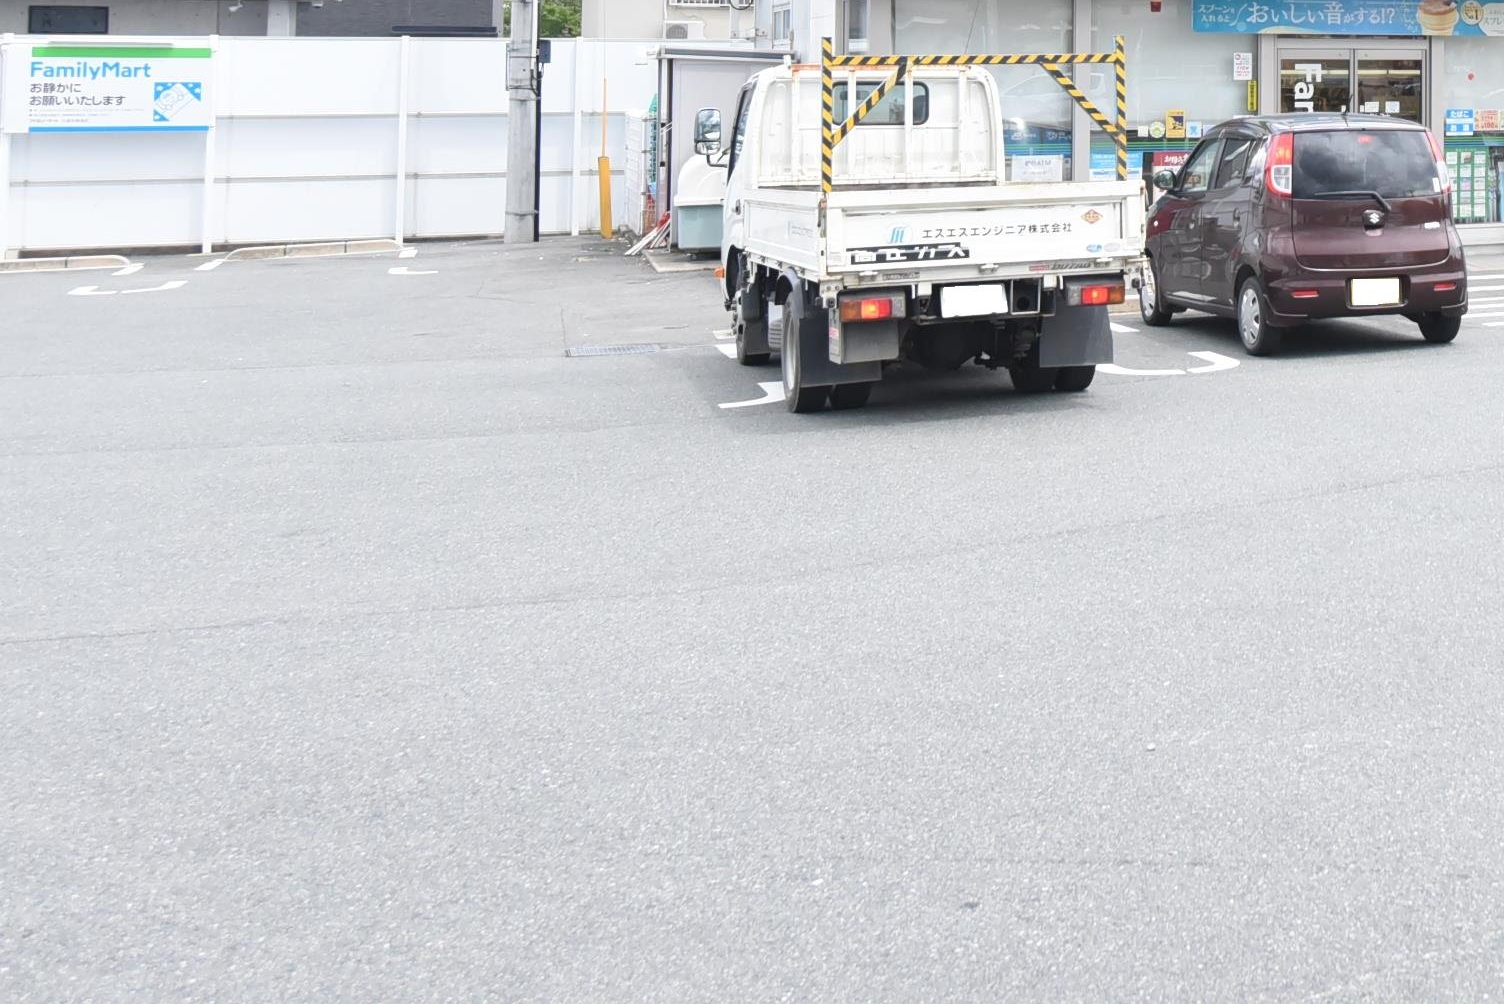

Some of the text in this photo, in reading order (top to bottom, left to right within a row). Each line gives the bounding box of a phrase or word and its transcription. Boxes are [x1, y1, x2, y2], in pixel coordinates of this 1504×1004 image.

[30, 61, 152, 80] FamilyMart
[29, 83, 82, 94] お静かに
[28, 95, 127, 106] お願いいたします
[921, 222, 1073, 240] エスエスエンジニア株式会社
